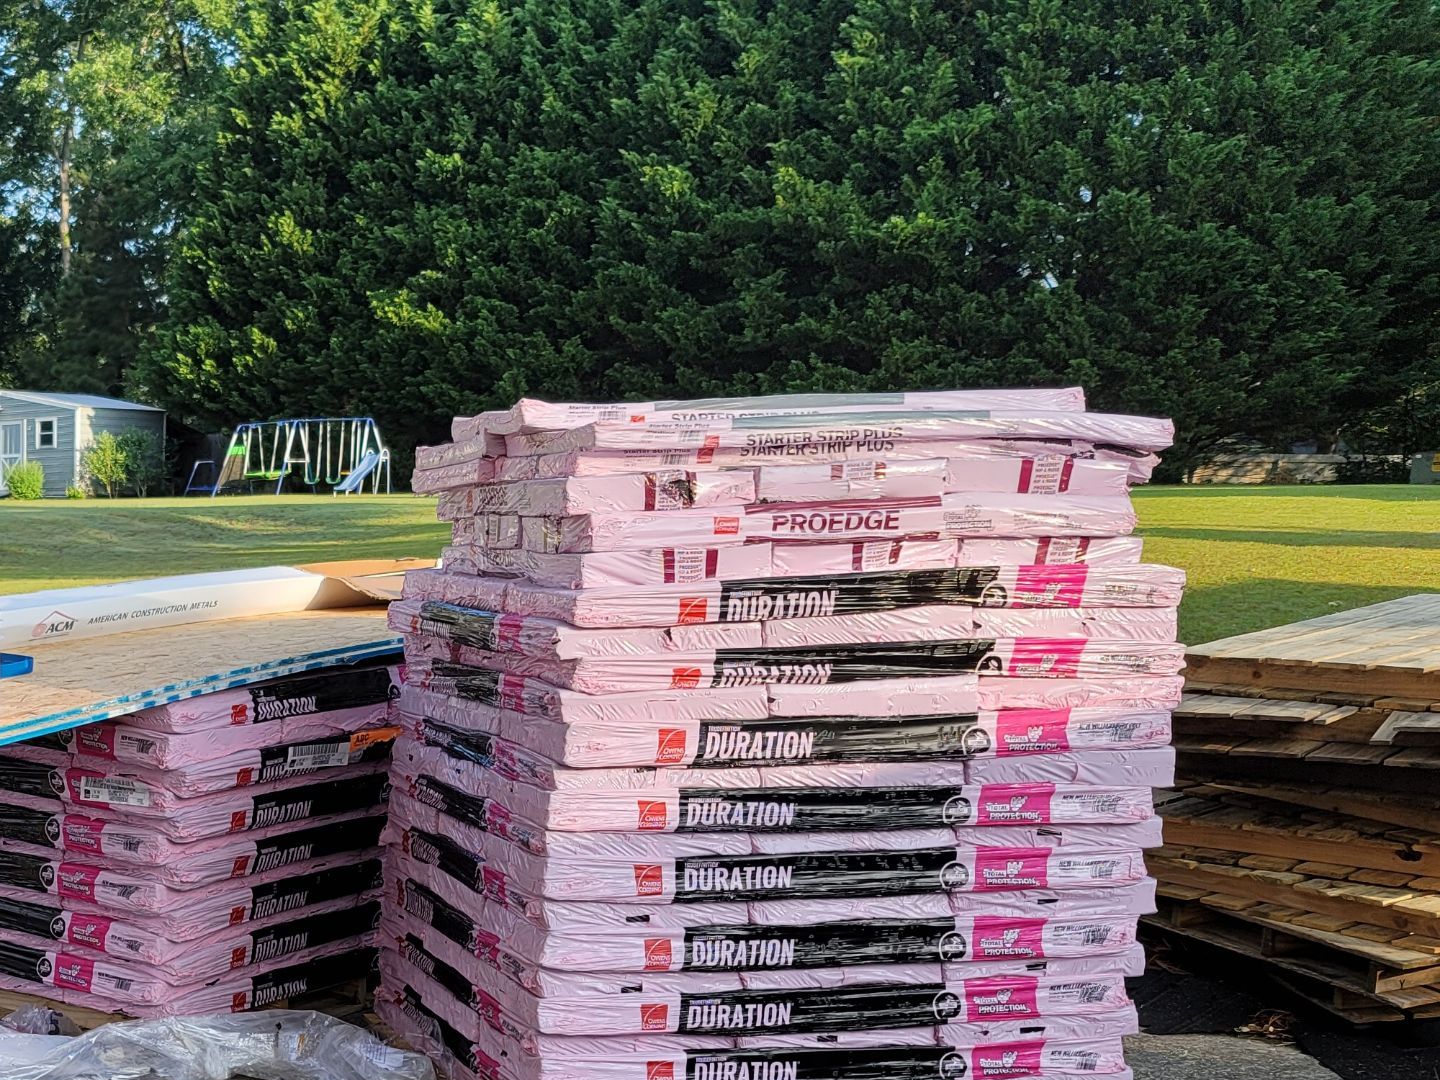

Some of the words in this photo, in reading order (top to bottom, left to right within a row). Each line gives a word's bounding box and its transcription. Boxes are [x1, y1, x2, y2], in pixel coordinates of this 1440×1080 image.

[747, 433, 813, 447] STARTER
[817, 430, 858, 443] STRIP
[863, 427, 903, 441] PLUS
[771, 510, 901, 534] PROEDGE
[45, 620, 75, 634] ACM
[87, 612, 129, 625] AMERICAN
[130, 604, 188, 618] CONSTRUCTION
[189, 600, 219, 610] METALS
[726, 590, 836, 622] DURATION
[258, 696, 319, 721] DURATION
[355, 733, 369, 743] ABC
[703, 731, 814, 760] DURATION
[252, 800, 313, 830] DURATION
[686, 801, 796, 827] DURATION
[990, 812, 1040, 821] PROTECTION
[256, 844, 313, 873] DURATION
[684, 865, 793, 892] DURATION
[987, 878, 1037, 886] PROTECTION
[253, 891, 309, 919] DURATION
[252, 932, 309, 963] DURATION
[691, 938, 796, 966] DURATION
[985, 947, 1034, 956] PROTECTION
[254, 978, 308, 1007] DURATION
[686, 1002, 792, 1029] DURATION
[978, 1004, 1027, 1013] PROTECTION
